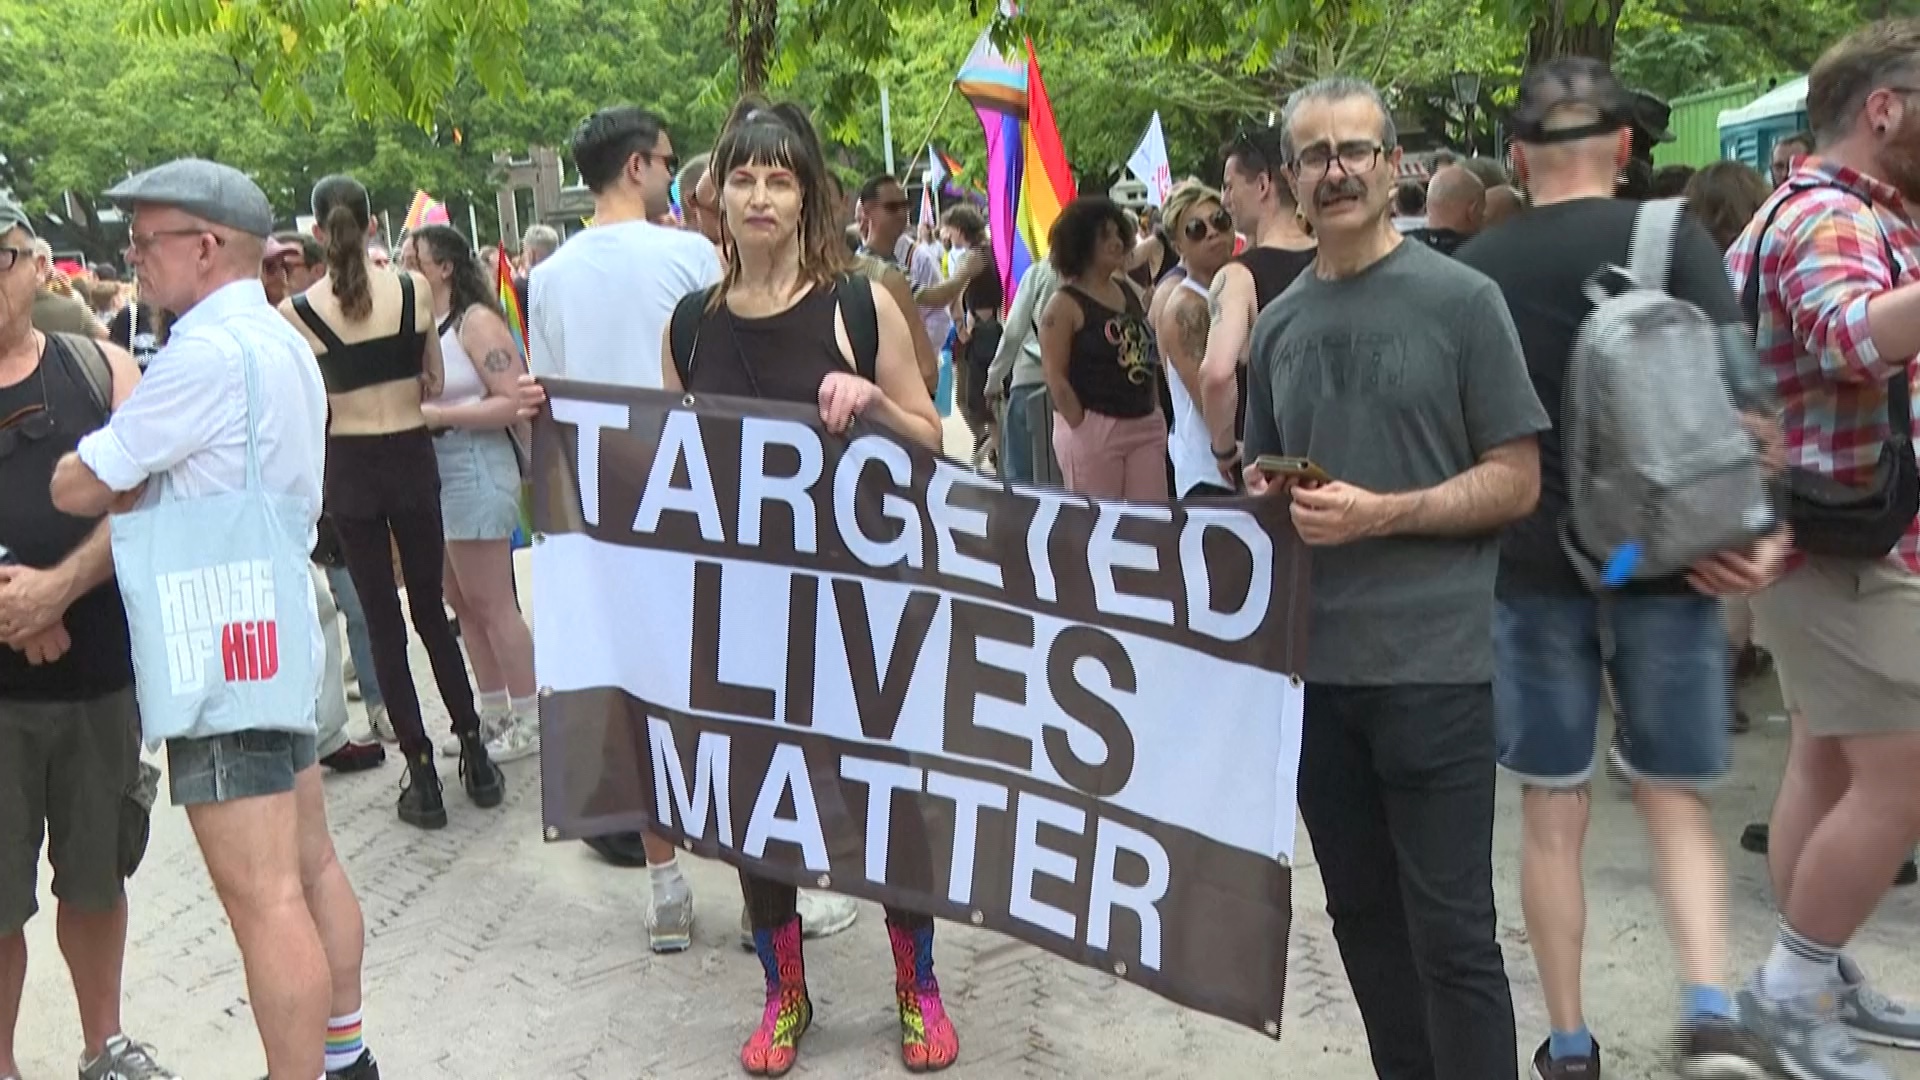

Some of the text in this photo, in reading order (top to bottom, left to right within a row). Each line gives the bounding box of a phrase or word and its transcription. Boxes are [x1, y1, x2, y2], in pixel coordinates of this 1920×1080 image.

[156, 560, 276, 633] HOUSE
[549, 399, 1274, 642] TARGETED
[165, 629, 214, 696] OF
[688, 561, 1137, 796] LIVES
[646, 715, 1171, 972] MATTER
